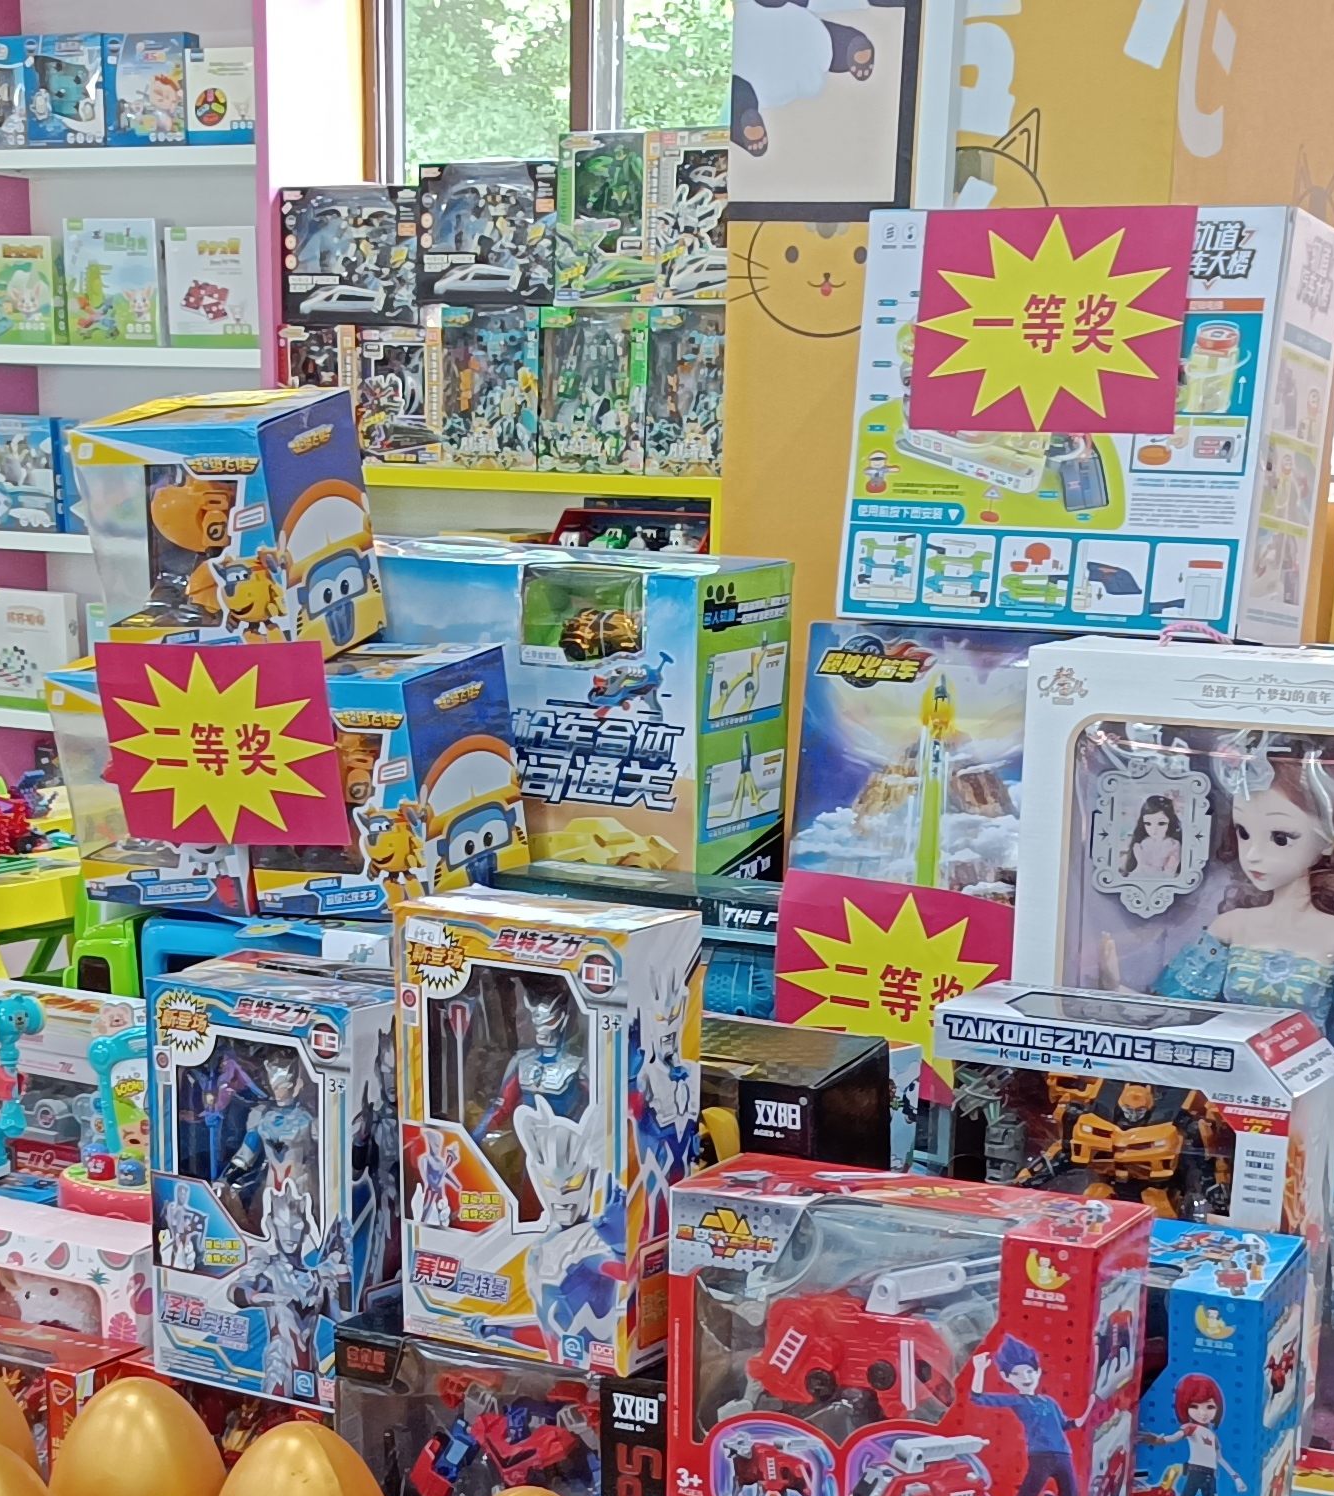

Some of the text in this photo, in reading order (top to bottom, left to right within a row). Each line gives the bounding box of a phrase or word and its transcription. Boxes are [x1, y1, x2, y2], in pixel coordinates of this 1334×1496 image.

[972, 292, 1119, 355] 一等奖
[1201, 684, 1332, 704] 给孩子一个梦幻的童年
[511, 708, 686, 761] 枪车合体
[152, 722, 278, 777] 二等奖
[724, 907, 763, 925] THE
[496, 927, 584, 957] 奥特之力
[160, 1008, 209, 1033] 新登场
[234, 998, 312, 1027] 奥特之力
[1211, 1092, 1235, 1104] AGES
[676, 1467, 703, 1488] 3+
